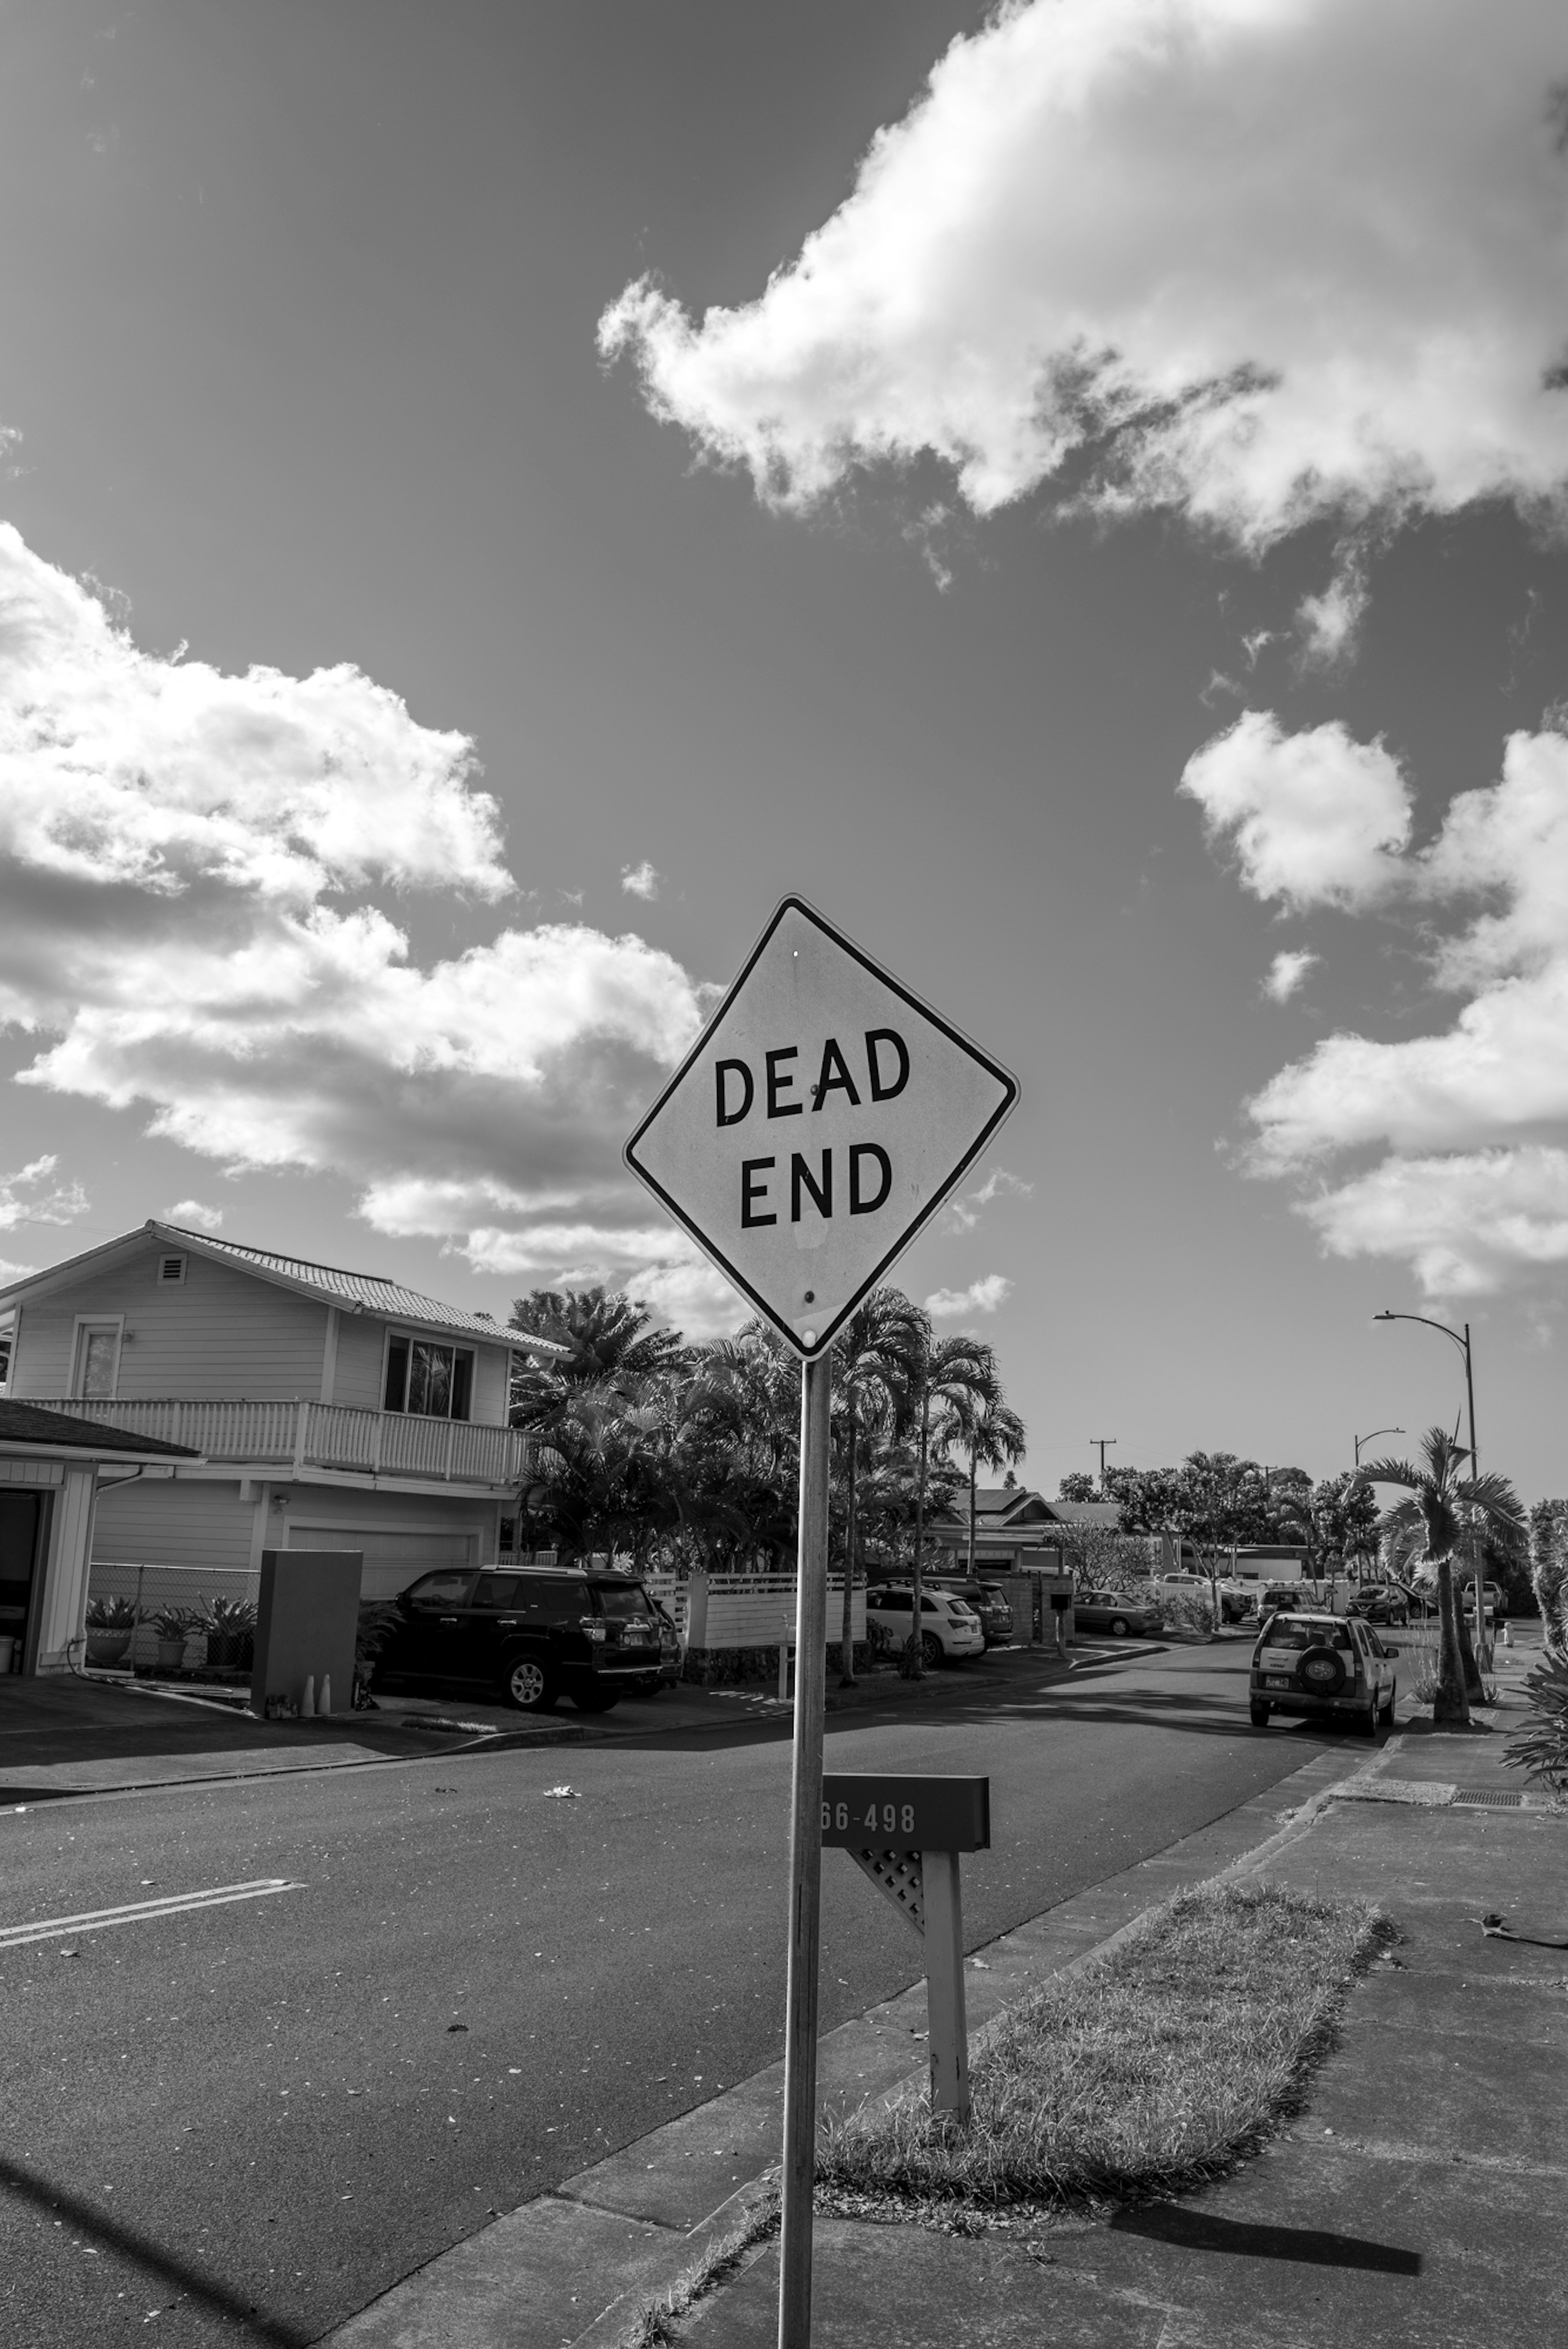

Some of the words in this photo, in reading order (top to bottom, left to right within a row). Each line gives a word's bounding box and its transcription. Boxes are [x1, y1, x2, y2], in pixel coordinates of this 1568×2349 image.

[715, 1029, 910, 1127] DEAD
[741, 1143, 892, 1229] END
[821, 1801, 915, 1833] 66-498
